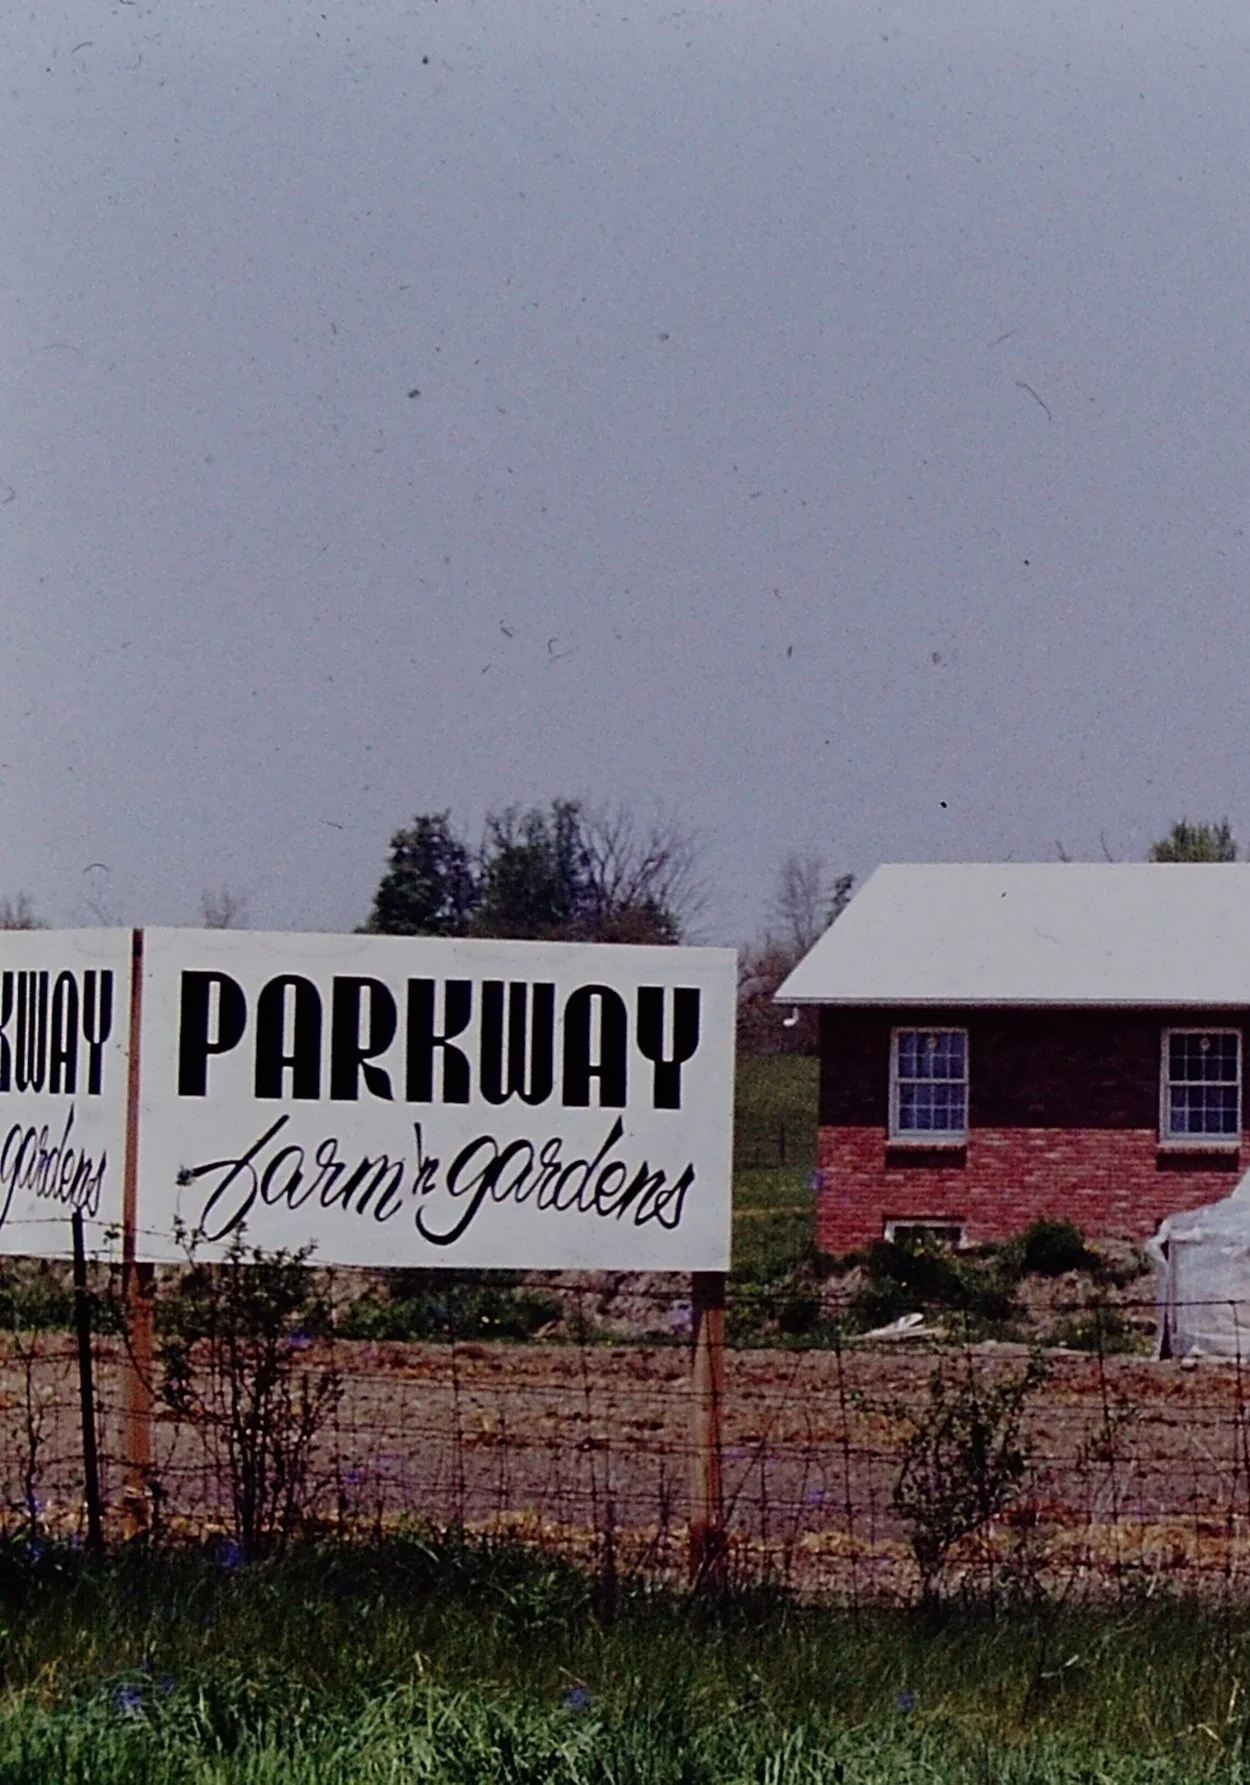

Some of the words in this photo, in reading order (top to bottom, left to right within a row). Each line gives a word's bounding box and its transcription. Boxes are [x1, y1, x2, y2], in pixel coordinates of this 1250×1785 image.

[178, 970, 701, 1110] PARKWAY
[0, 1102, 107, 1229] gardens
[191, 1114, 403, 1241] farm
[415, 1114, 695, 1245] gardens
